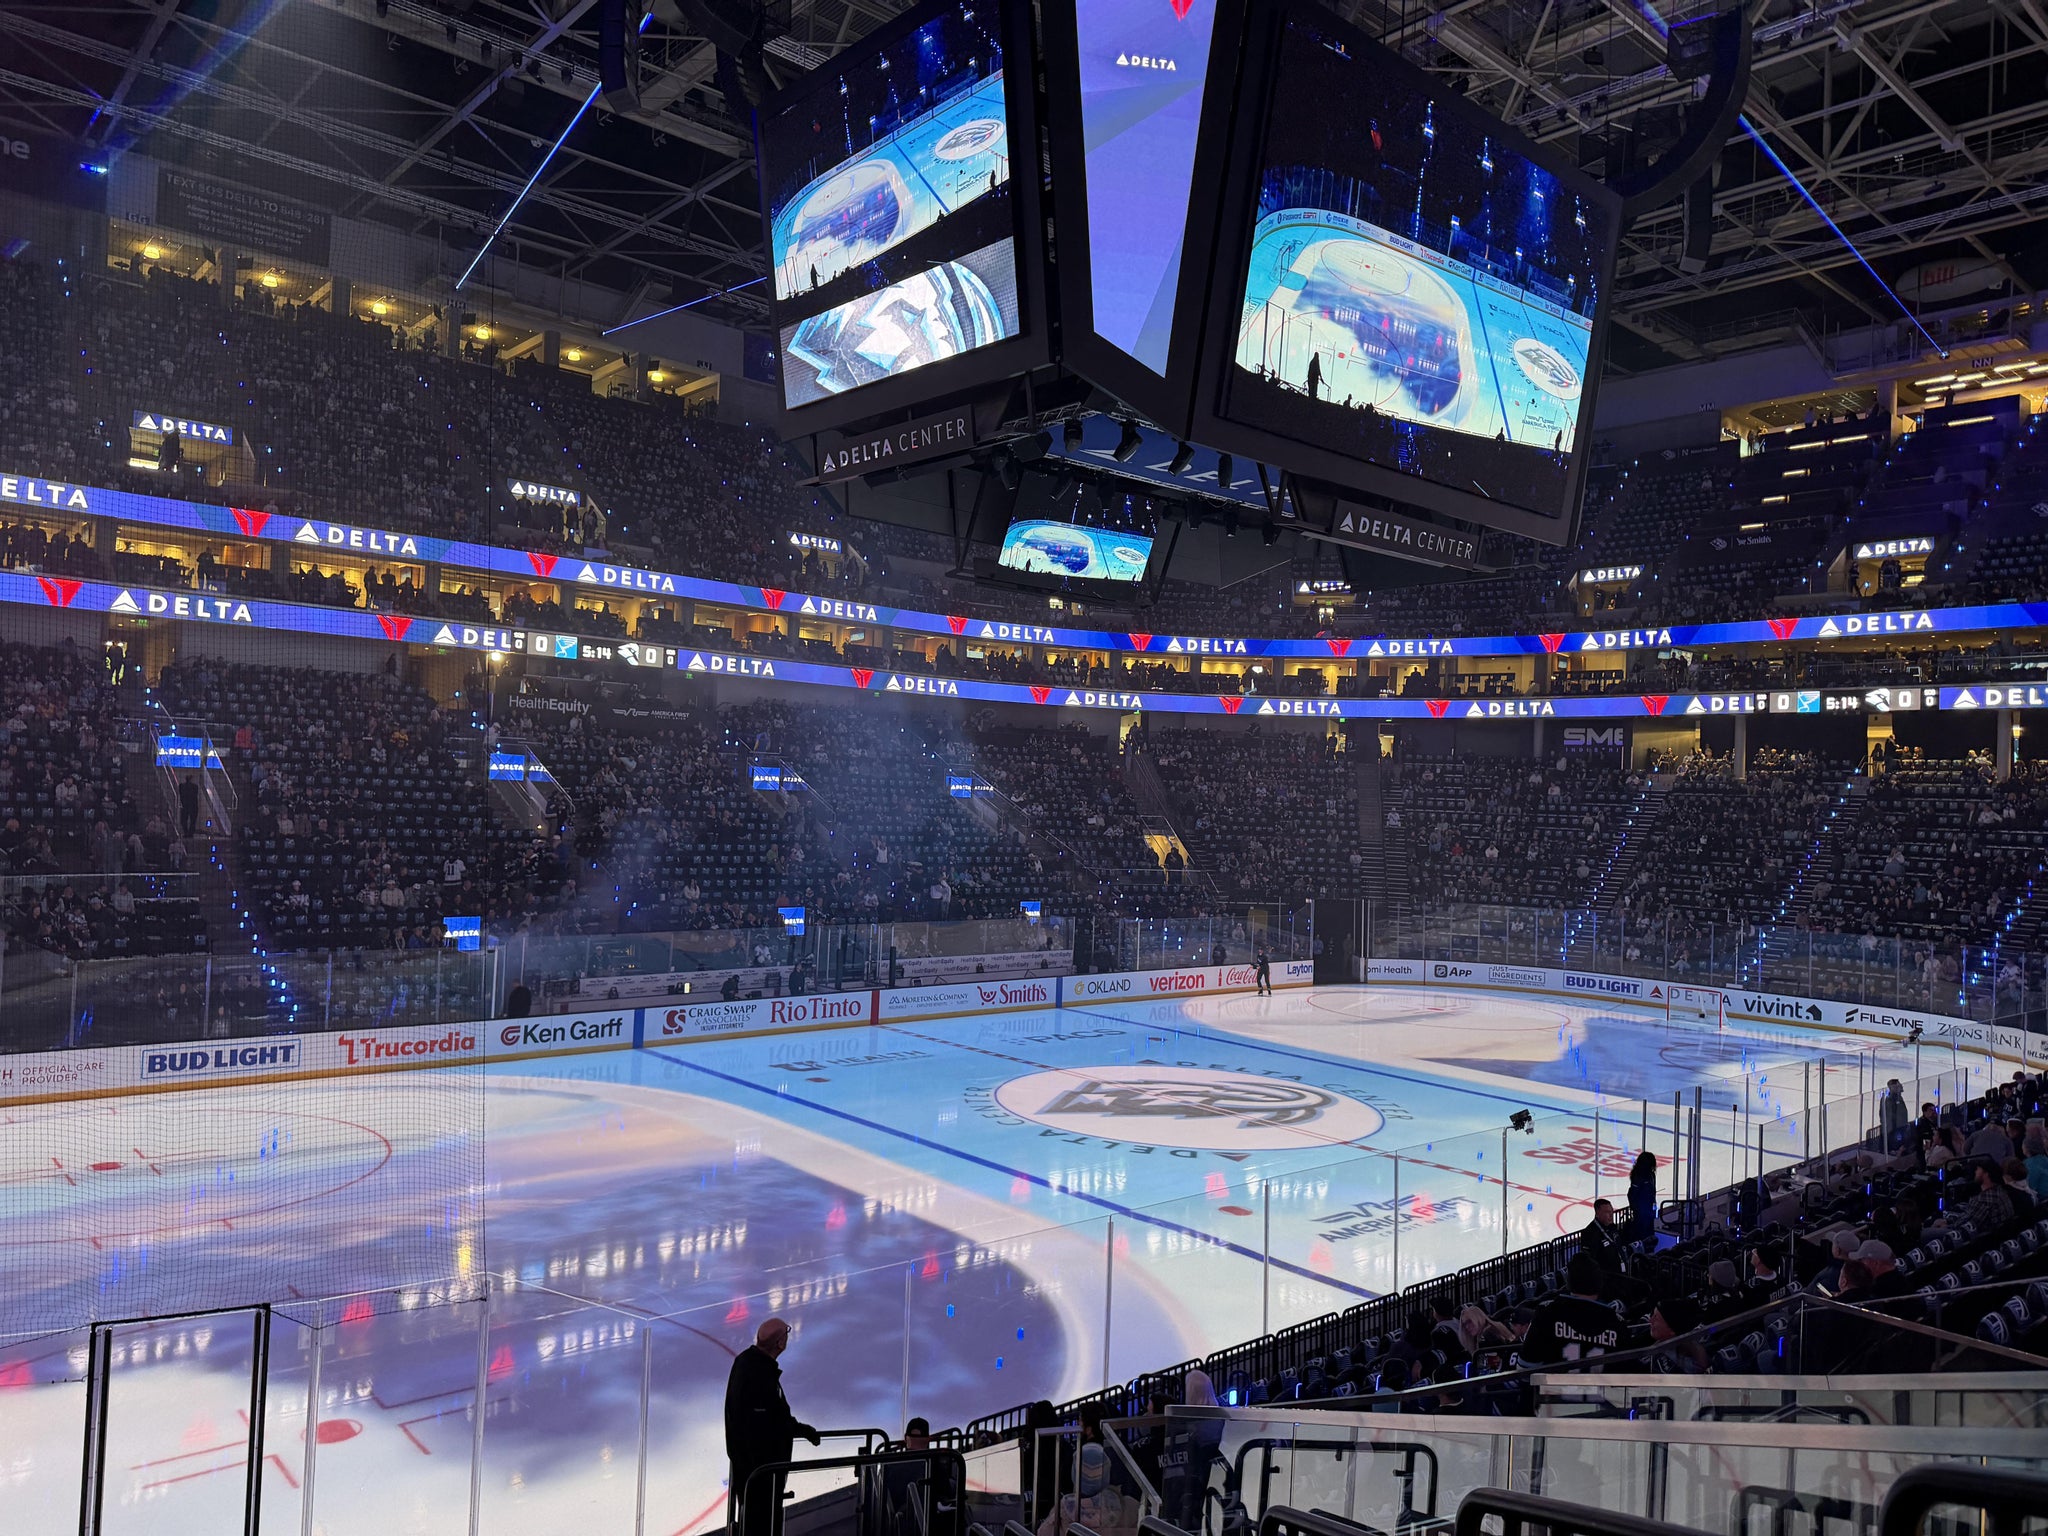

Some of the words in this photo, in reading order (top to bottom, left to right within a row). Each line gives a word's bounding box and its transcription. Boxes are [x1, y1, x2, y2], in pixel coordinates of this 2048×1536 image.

[1131, 55, 1176, 71] DELTA
[167, 173, 196, 189] TEXT
[262, 200, 279, 213] TO
[1390, 236, 1400, 245] BUD
[1400, 240, 1414, 251] LIGHT
[1923, 265, 1955, 287] bill
[1972, 356, 1994, 369] NN
[162, 418, 227, 441] DELTA
[839, 438, 894, 468] DELTA
[899, 418, 966, 452] CENTER
[1, 477, 89, 509] ELTA
[527, 484, 577, 504] DELTA
[328, 525, 418, 555] DELTA
[801, 535, 839, 551] DELTA
[1358, 516, 1412, 546] DELTA
[1417, 531, 1473, 560] CENTER
[1876, 540, 1930, 556] DELTA
[603, 566, 675, 592] DELTA
[1598, 567, 1641, 580] DELTA
[149, 595, 252, 623] DELTA
[821, 602, 877, 622] DELTA
[1847, 613, 1933, 632] DELTA
[462, 627, 512, 650] DEL
[999, 625, 1055, 642] DELTA
[1604, 630, 1672, 649] DELTA
[515, 639, 523, 650] 0
[535, 636, 549, 653] 0
[582, 645, 612, 661] 5:14
[645, 648, 658, 665] 0
[1187, 638, 1247, 654] DELTA
[1389, 640, 1454, 655] DELTA
[667, 656, 674, 666] 0
[710, 657, 775, 677] DELTA
[905, 677, 959, 695] DELTA
[509, 695, 590, 715] HealthEquity
[1085, 691, 1143, 709] DELTA
[1712, 696, 1755, 712] DEL
[1758, 700, 1766, 710] 0
[1778, 694, 1790, 710] 0
[1826, 696, 1858, 710] 5:14
[1899, 691, 1912, 707] 0
[1926, 696, 1935, 706] 0
[1986, 687, 2048, 706] DEL
[1279, 701, 1342, 716] DELTA
[1488, 701, 1555, 717] DELTA
[1563, 727, 1624, 746] SME
[169, 748, 201, 756] DELTA
[498, 763, 524, 771] DELTA
[452, 929, 480, 937] DELTA
[1287, 963, 1313, 977] Layton
[1384, 965, 1412, 975] Health
[1492, 971, 1543, 982] INGREDIENTS
[1087, 978, 1131, 995] OKLAND
[1150, 971, 1205, 992] verizon
[1566, 975, 1596, 989] BUD
[1598, 979, 1640, 995] LIGHT
[999, 983, 1047, 1005] Smith's
[688, 1006, 722, 1018] CRAIG
[724, 1004, 758, 1015] SWAPP
[770, 1000, 807, 1024] Rio
[808, 997, 862, 1020] Tinto
[1743, 995, 1804, 1019] vivint
[702, 1013, 751, 1024] ASSOCIATES
[718, 1022, 744, 1031] ATTORNEYS
[1860, 1013, 1924, 1030] FILEVINE
[523, 1023, 566, 1045] Ken
[569, 1017, 623, 1040] Garff
[1023, 1028, 1127, 1044] PACS
[1937, 1022, 1982, 1040] ZIONS
[360, 1031, 476, 1059] Trucordia
[147, 1051, 210, 1074] BUD
[214, 1044, 295, 1069] LIGHT
[826, 1050, 927, 1065] HEALTH
[22, 1064, 73, 1076] OFFICIAL
[76, 1062, 105, 1072] CARE
[21, 1073, 78, 1085] PROVIDER
[1176, 1061, 1303, 1081] DELTA
[1322, 1083, 1415, 1121] CENTER
[963, 1086, 1025, 1126] CENTER
[1039, 1128, 1198, 1160] DELTA
[1522, 1138, 1623, 1165] SEAT
[1579, 1148, 1688, 1178] GE
[1318, 1212, 1422, 1243] AMERICA
[1412, 1196, 1479, 1218] FIRST
